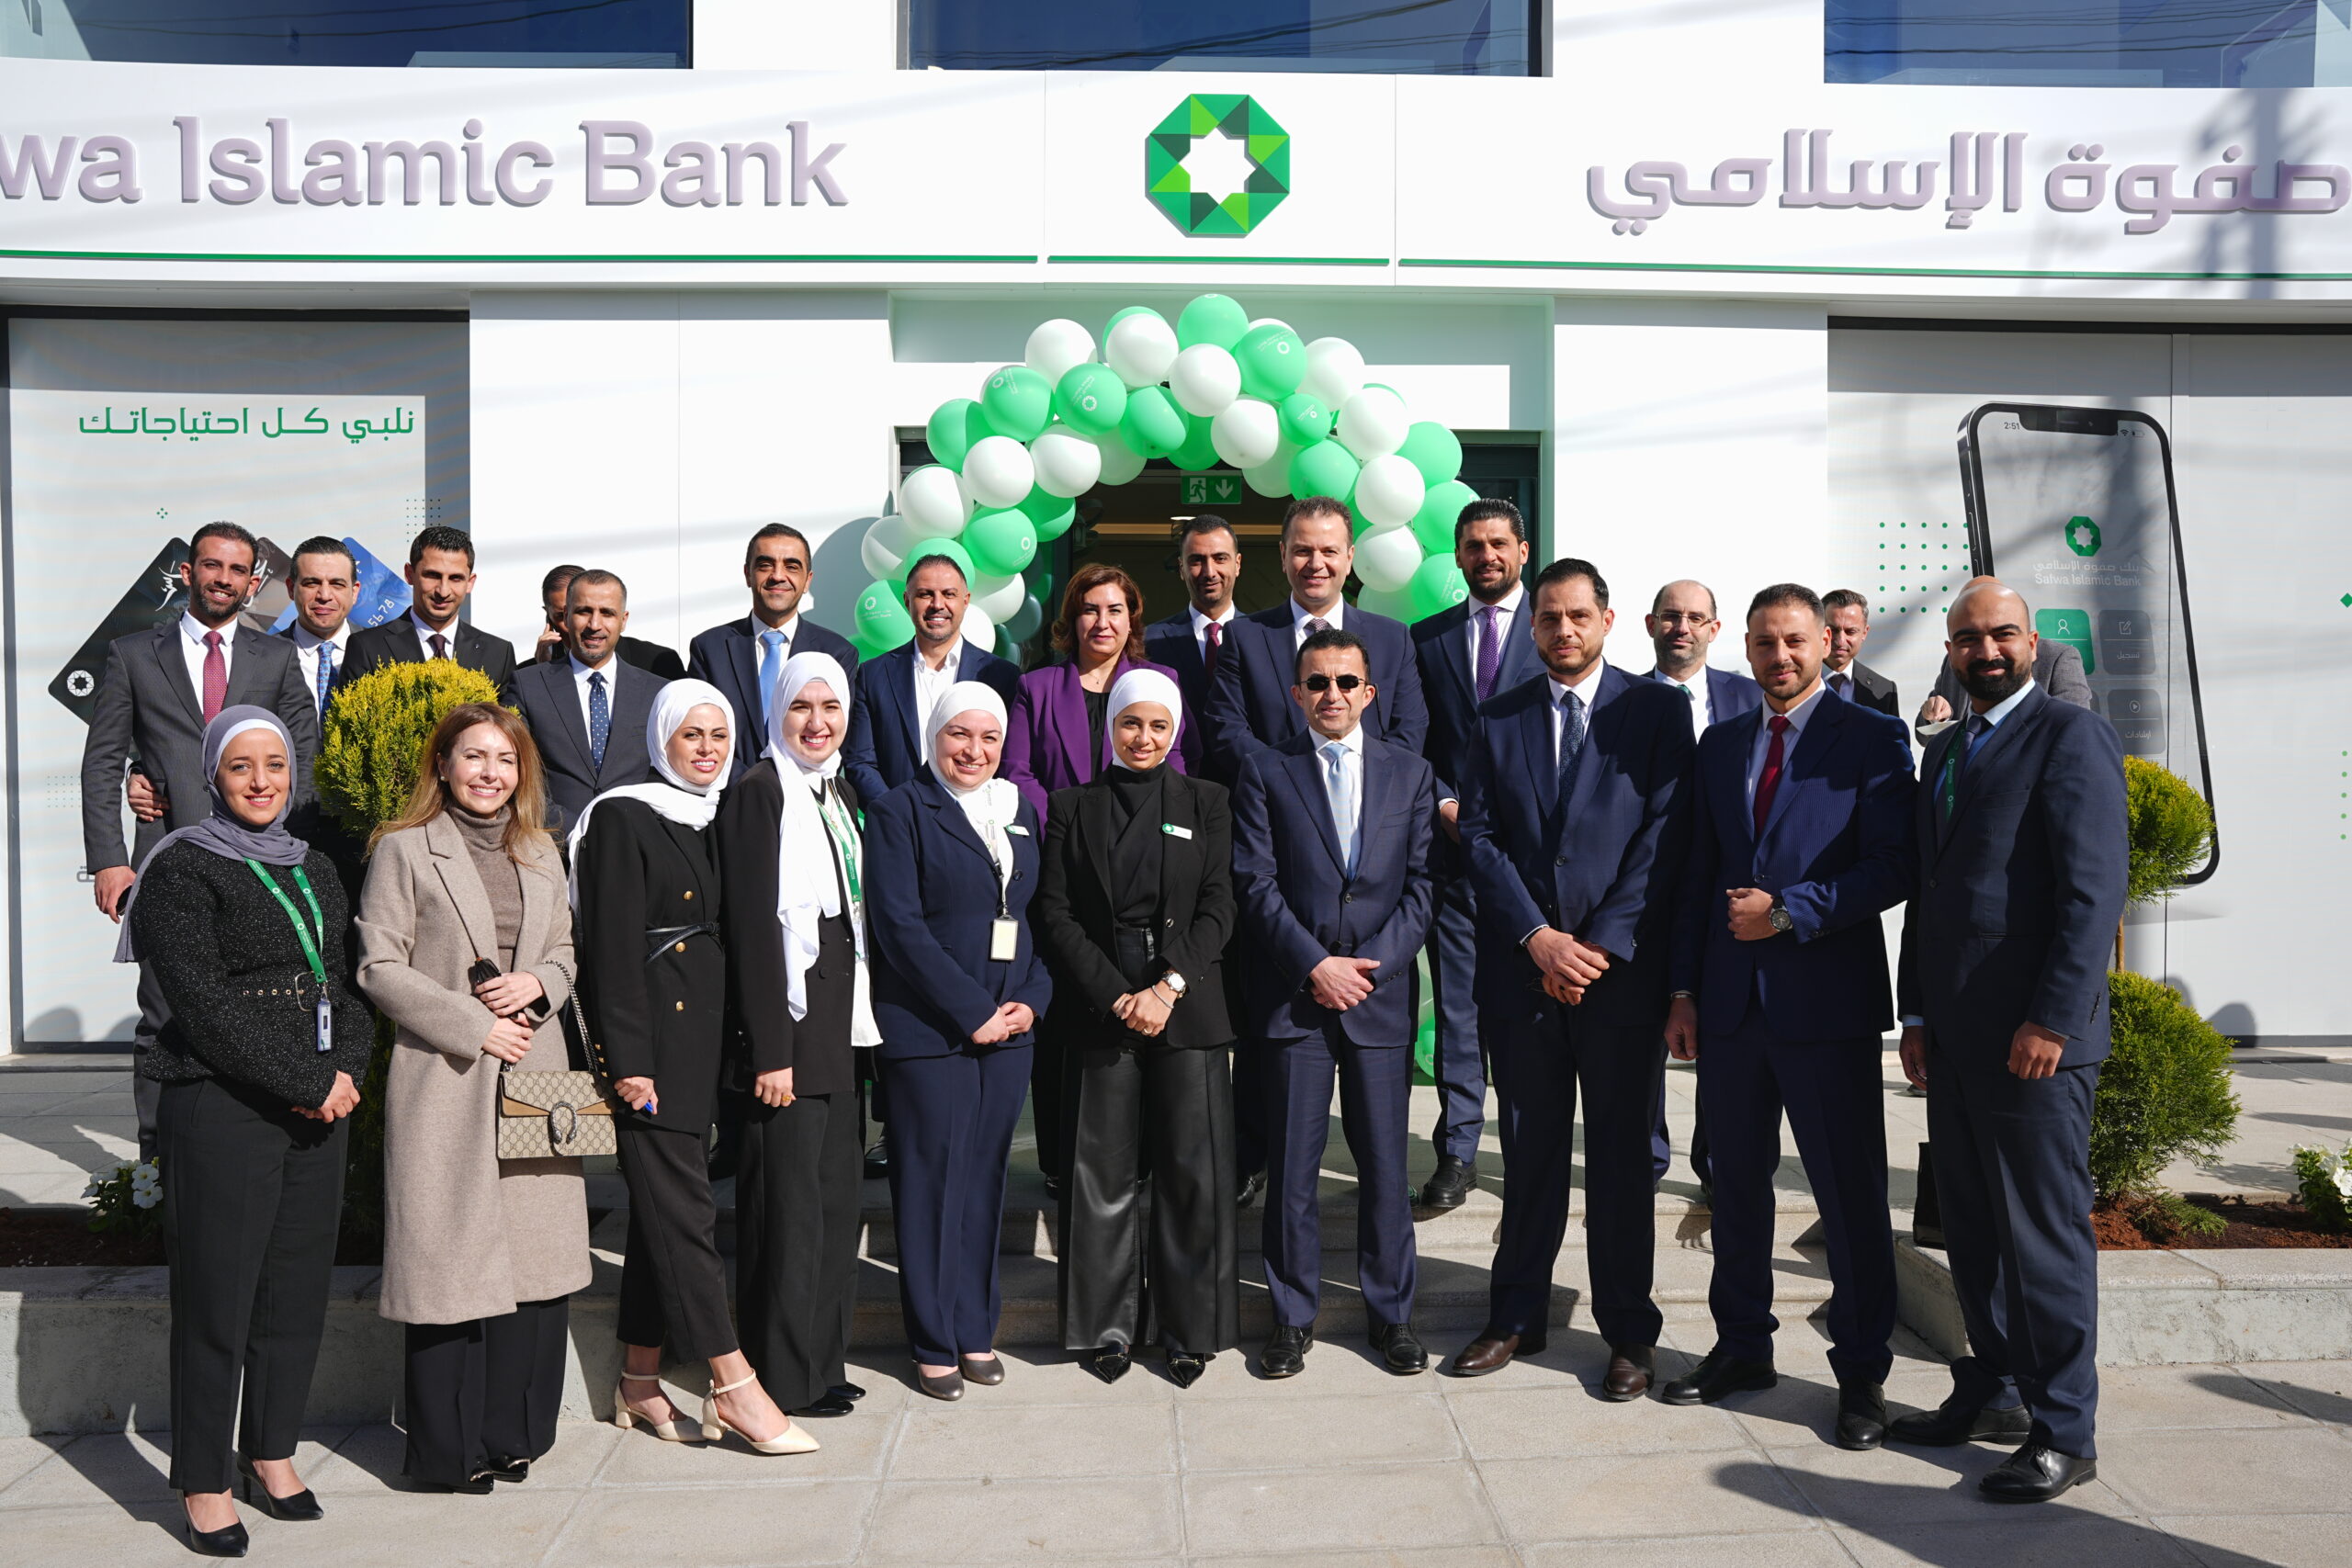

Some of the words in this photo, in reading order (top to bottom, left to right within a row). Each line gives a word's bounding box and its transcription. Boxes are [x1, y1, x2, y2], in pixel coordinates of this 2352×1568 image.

[173, 116, 555, 208] Islamic
[579, 120, 849, 208] Bank
[1587, 128, 2029, 236] الإسلامي
[2044, 143, 2352, 236] صفوة
[78, 407, 249, 442] احتياجاتك
[261, 407, 330, 439] كل
[342, 406, 415, 444] نلبي
[2004, 422, 2020, 430] 2:51
[2034, 572, 2069, 585] Safwa
[2071, 572, 2112, 586] Islamic
[2114, 574, 2142, 587] Bank
